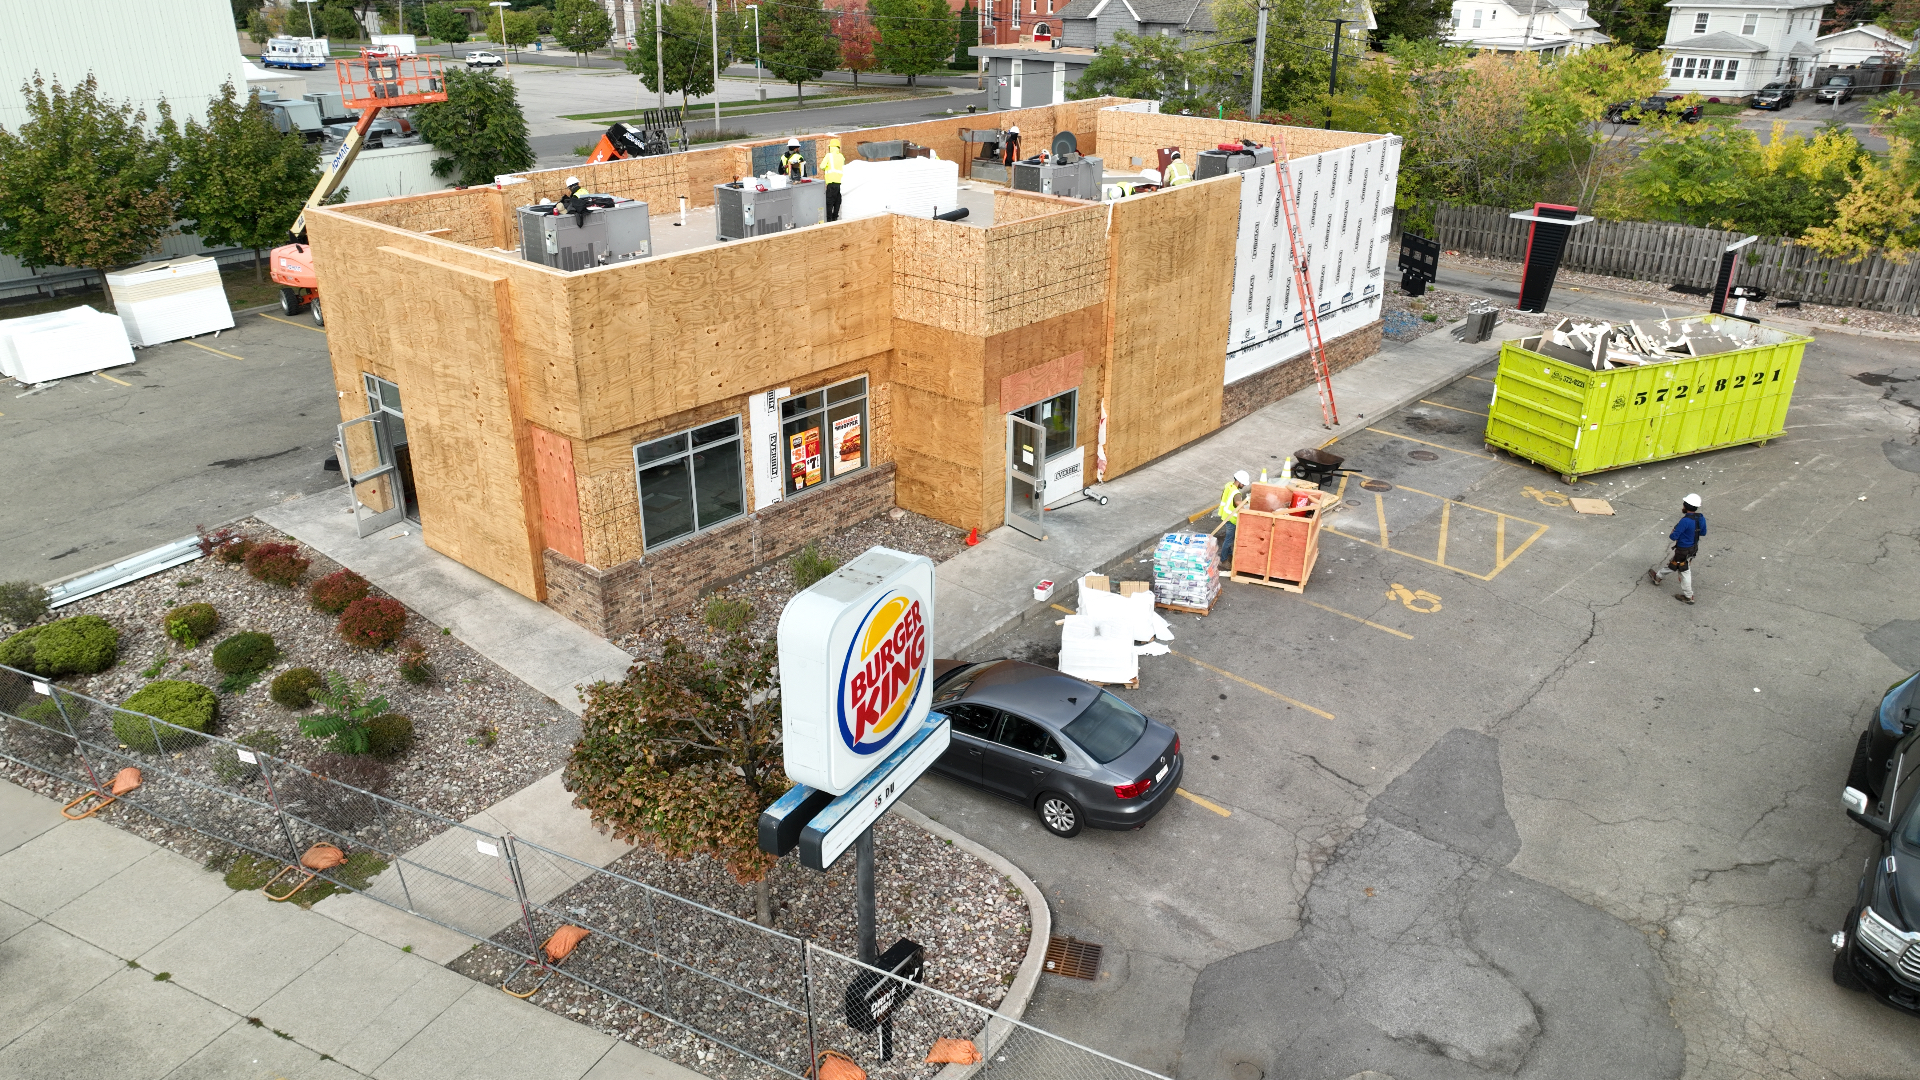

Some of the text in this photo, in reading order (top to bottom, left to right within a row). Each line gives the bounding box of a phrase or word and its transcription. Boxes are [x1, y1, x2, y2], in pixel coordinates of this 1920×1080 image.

[834, 420, 858, 431] WHOPPER
[806, 457, 817, 470] $7
[851, 599, 922, 710] BURGER
[853, 624, 925, 746] KING
[871, 985, 897, 1012] DRIVE
[873, 996, 894, 1020] THRU
